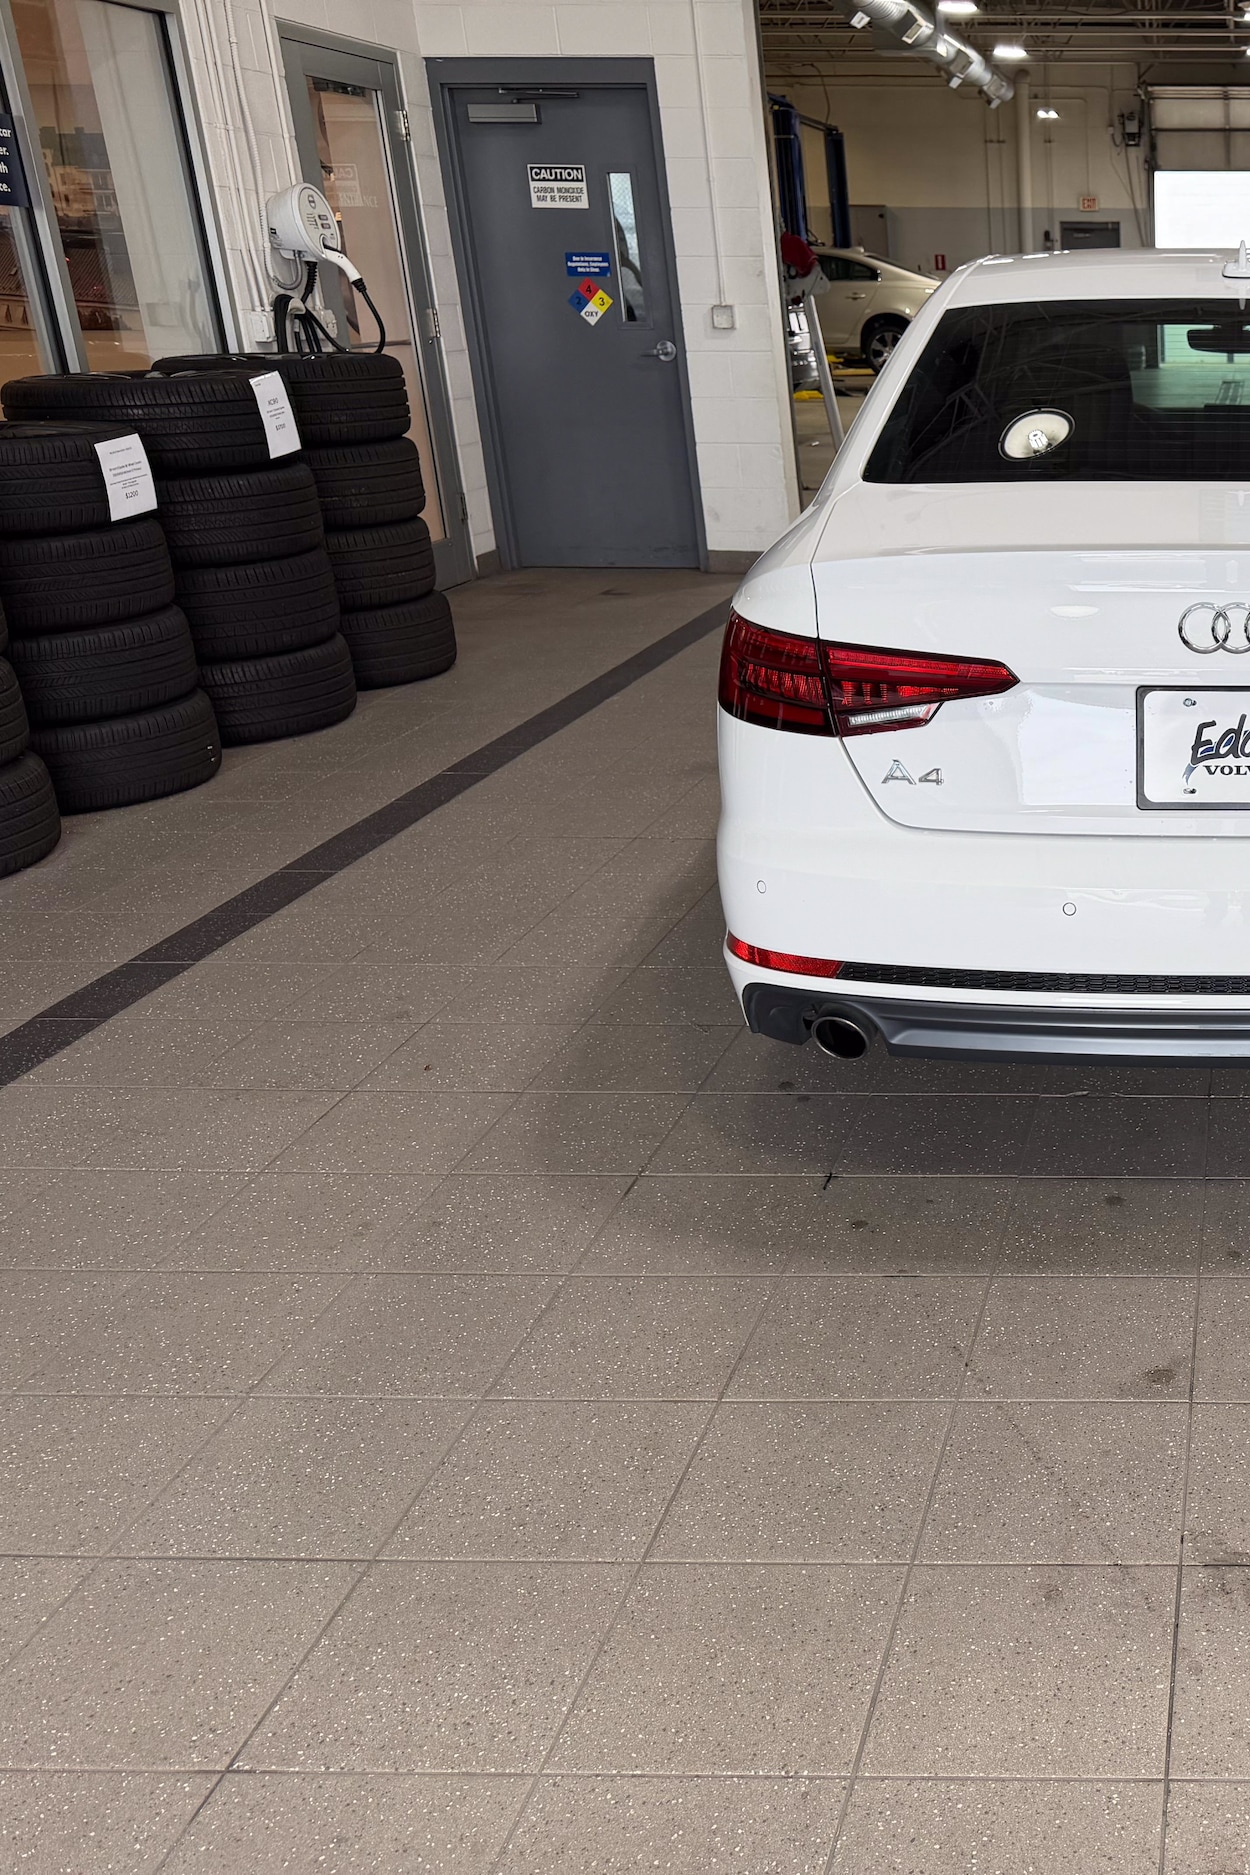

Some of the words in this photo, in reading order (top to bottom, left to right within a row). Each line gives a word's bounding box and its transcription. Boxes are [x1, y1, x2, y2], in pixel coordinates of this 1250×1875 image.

[531, 168, 582, 180] CAUTION
[533, 186, 555, 194] CARBON
[556, 186, 585, 195] MONOXIDE
[536, 194, 548, 202] MAY
[558, 195, 582, 203] PRESENT
[585, 284, 592, 295] 4
[575, 296, 582, 305] 2
[598, 297, 606, 306] 3
[881, 759, 944, 785] A4
